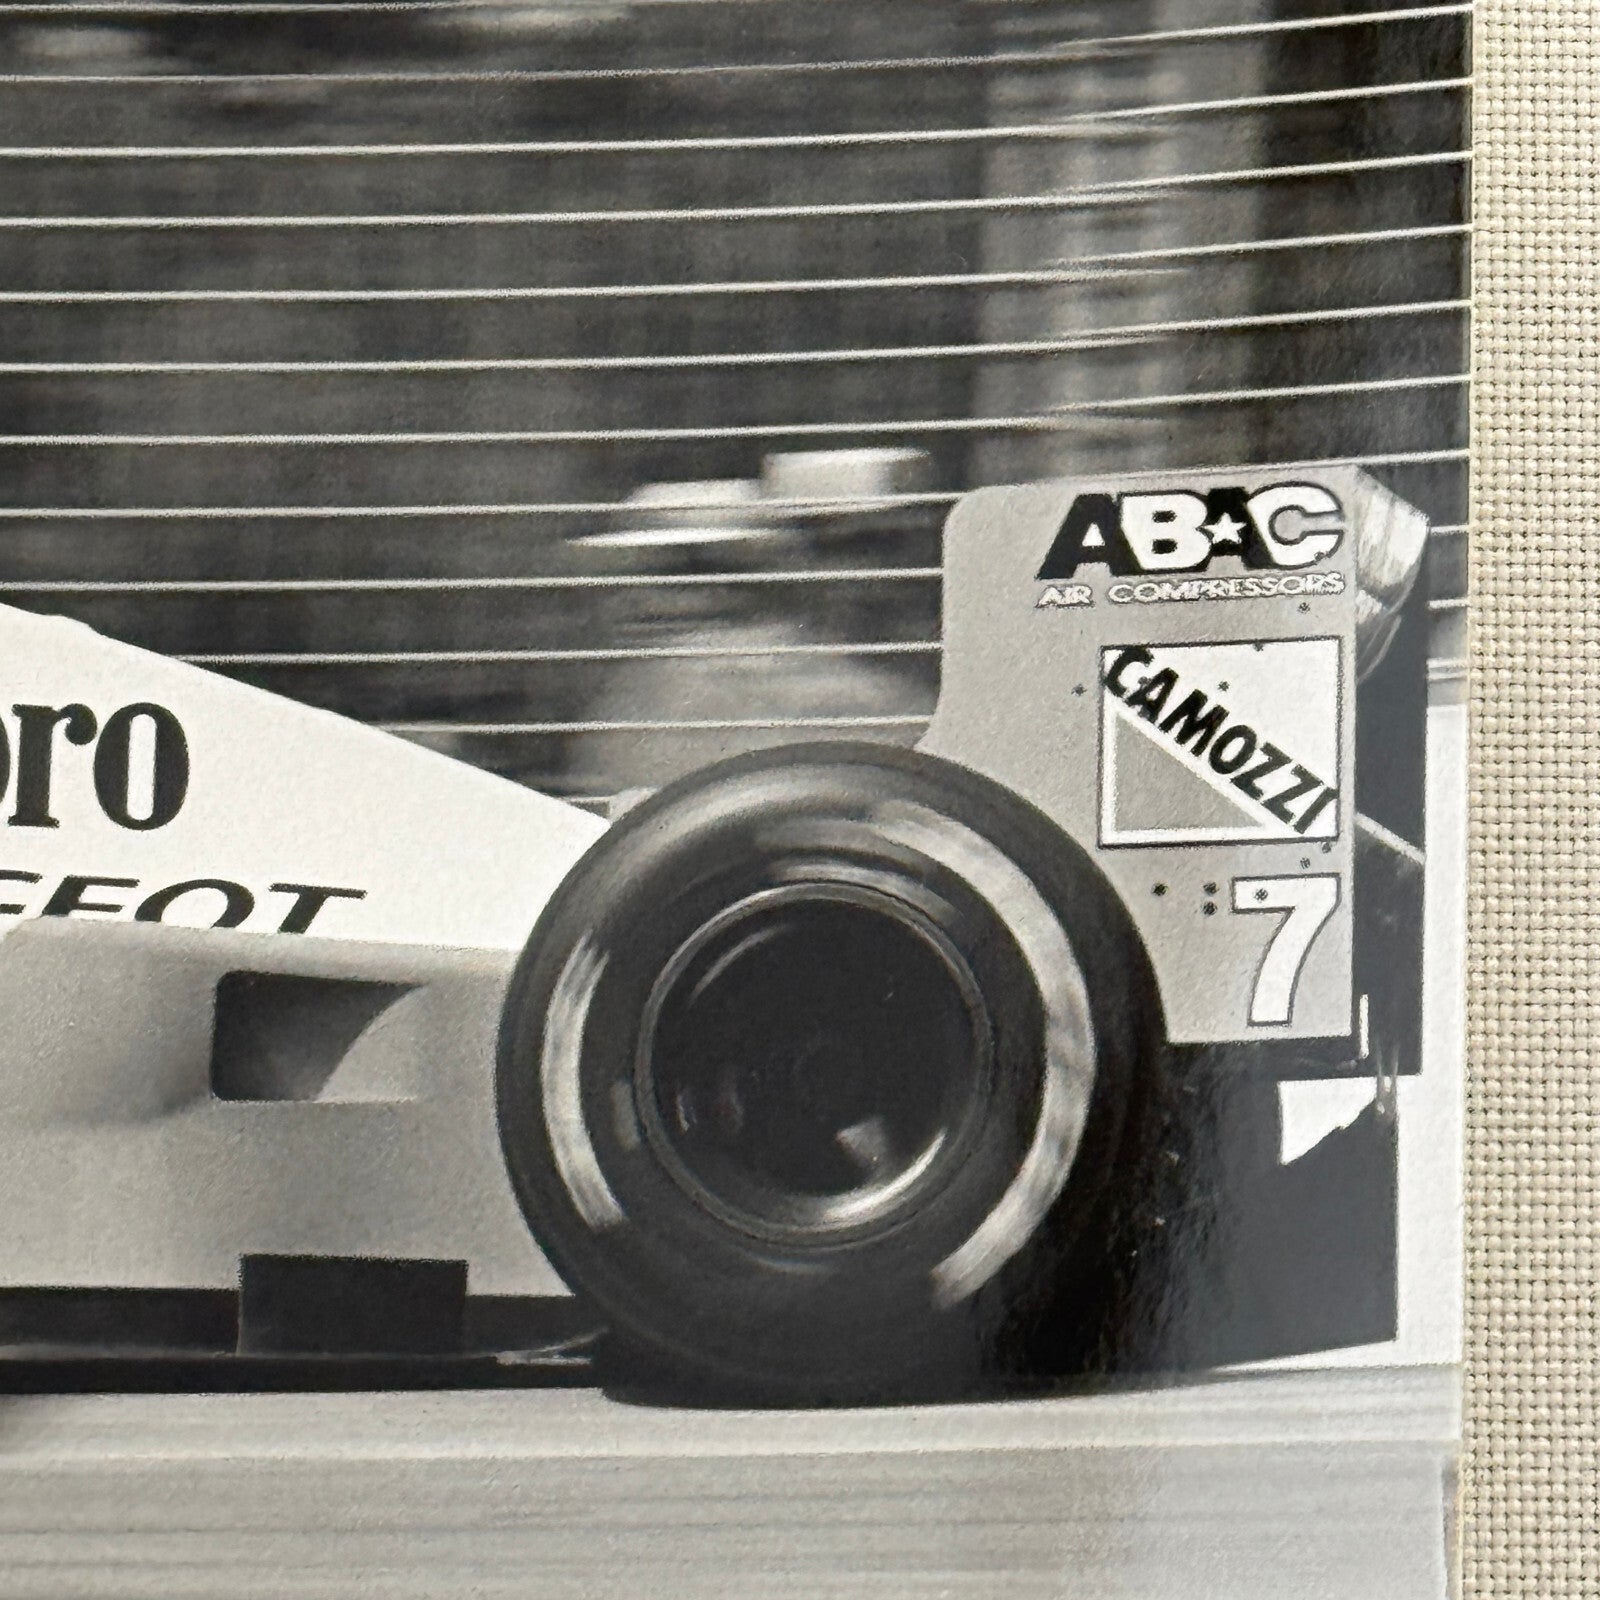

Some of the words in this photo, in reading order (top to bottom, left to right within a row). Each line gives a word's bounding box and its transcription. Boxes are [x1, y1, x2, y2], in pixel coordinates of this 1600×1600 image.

[1035, 481, 1344, 580] ABAC
[1035, 585, 1096, 608] AIR
[1108, 571, 1345, 603] COMPRESSORS
[0, 702, 190, 830] ro
[1104, 646, 1338, 834] CAMOZZI
[1231, 873, 1340, 1027] 7
